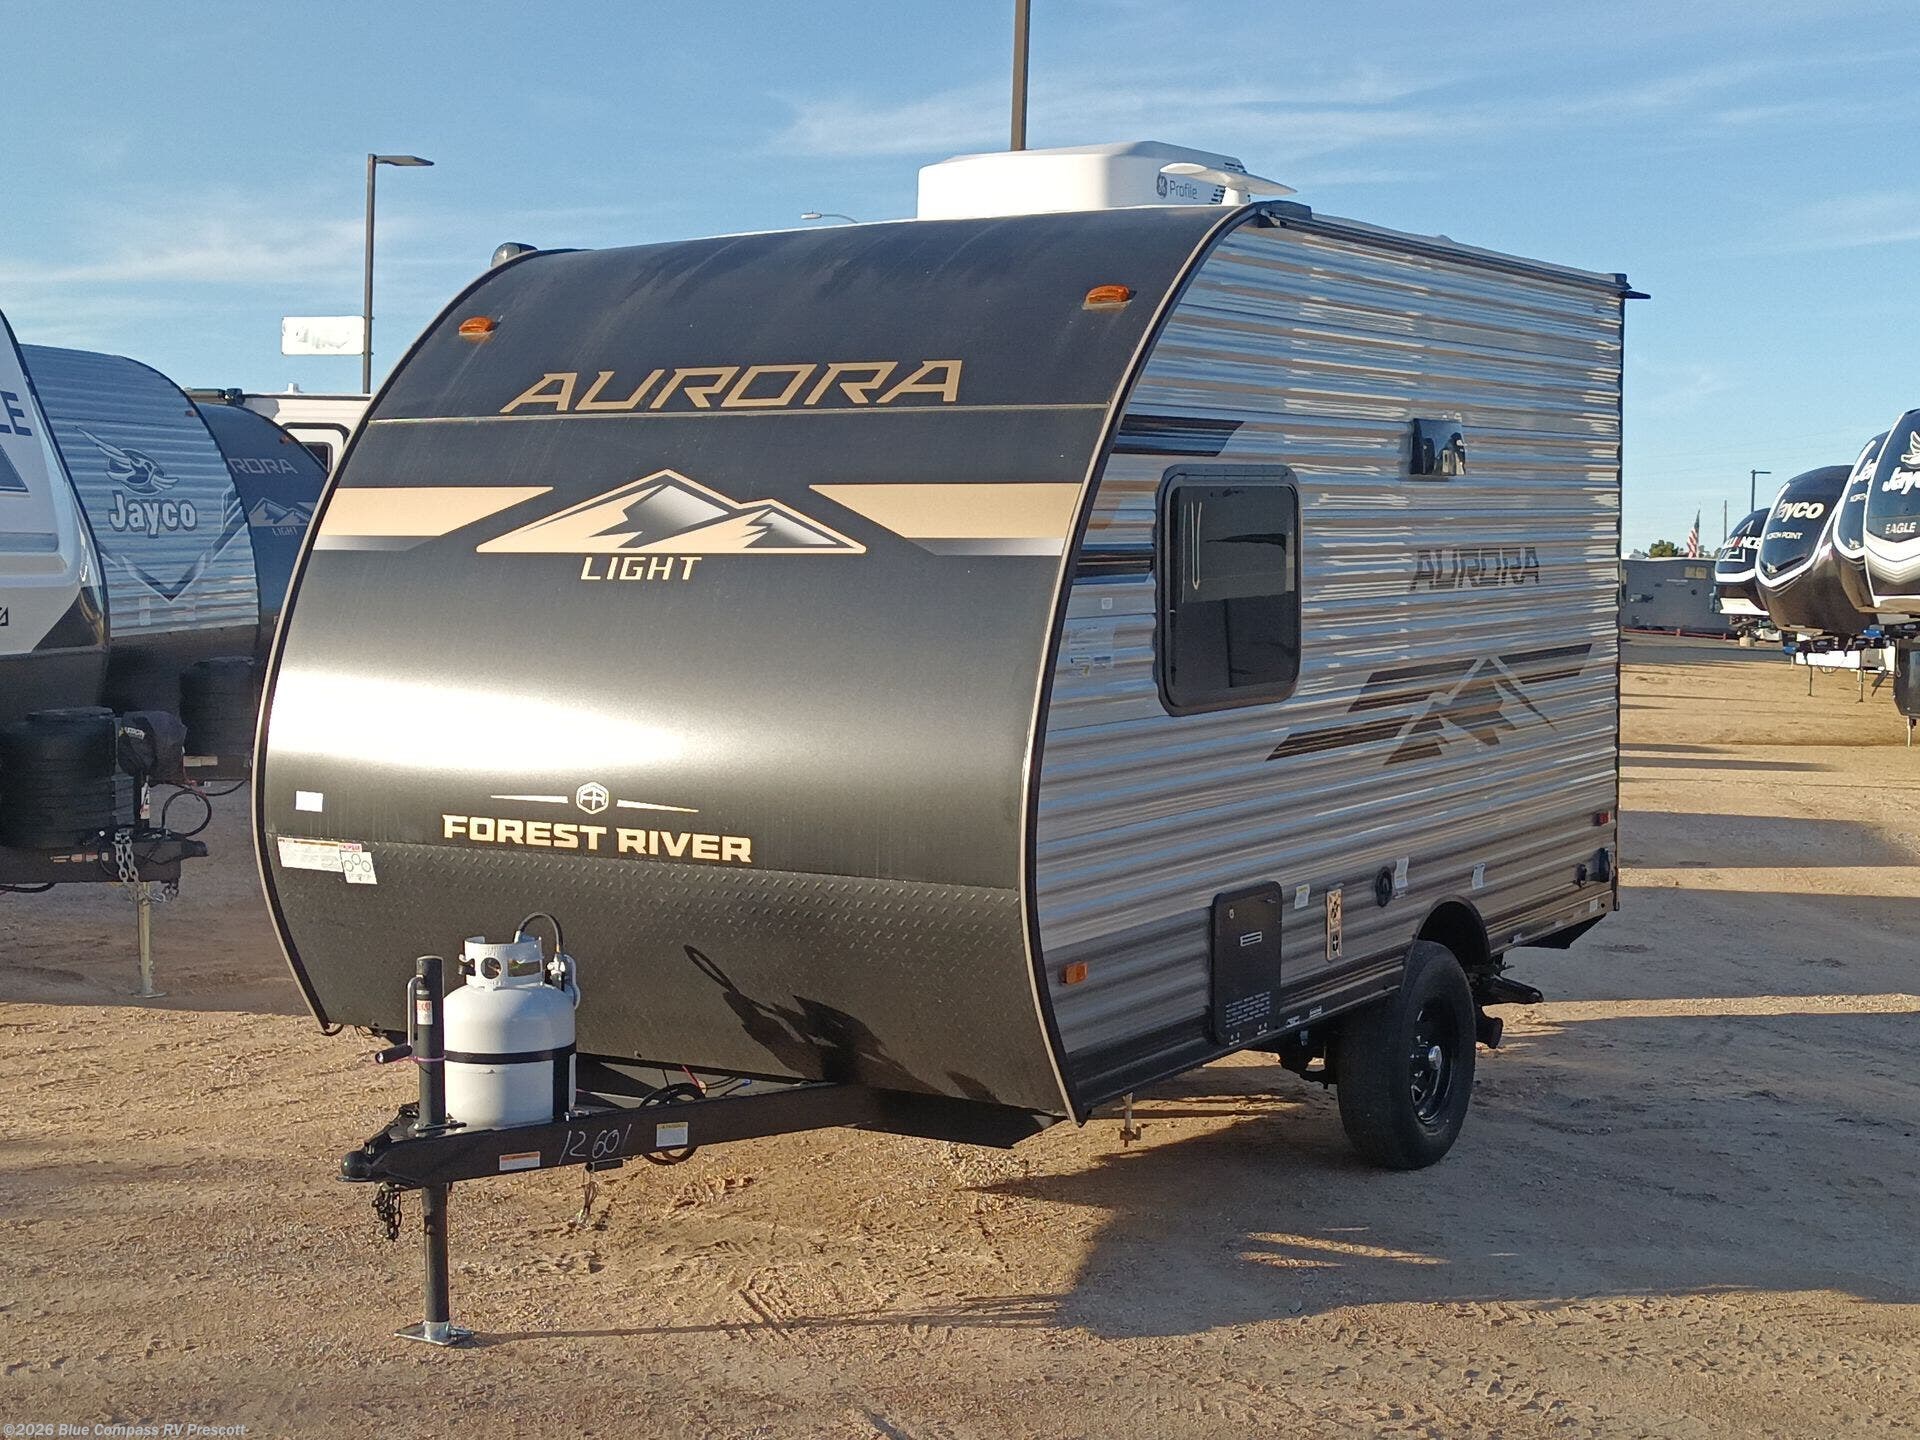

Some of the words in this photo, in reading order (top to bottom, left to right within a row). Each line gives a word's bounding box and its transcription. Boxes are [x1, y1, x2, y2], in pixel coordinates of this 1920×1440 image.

[1169, 180, 1198, 199] Profile
[499, 359, 963, 413] AURORA
[226, 458, 299, 474] RORA
[108, 490, 198, 539] Jayco
[1771, 499, 1825, 522] Jayco
[272, 526, 298, 537] LIGHT
[1885, 522, 1917, 534] EAGLE
[580, 556, 703, 581] LIGHT
[1410, 546, 1540, 591] AURORA
[442, 814, 608, 850] FOREST
[616, 827, 752, 863] RIVER
[557, 1123, 632, 1165] 12601
